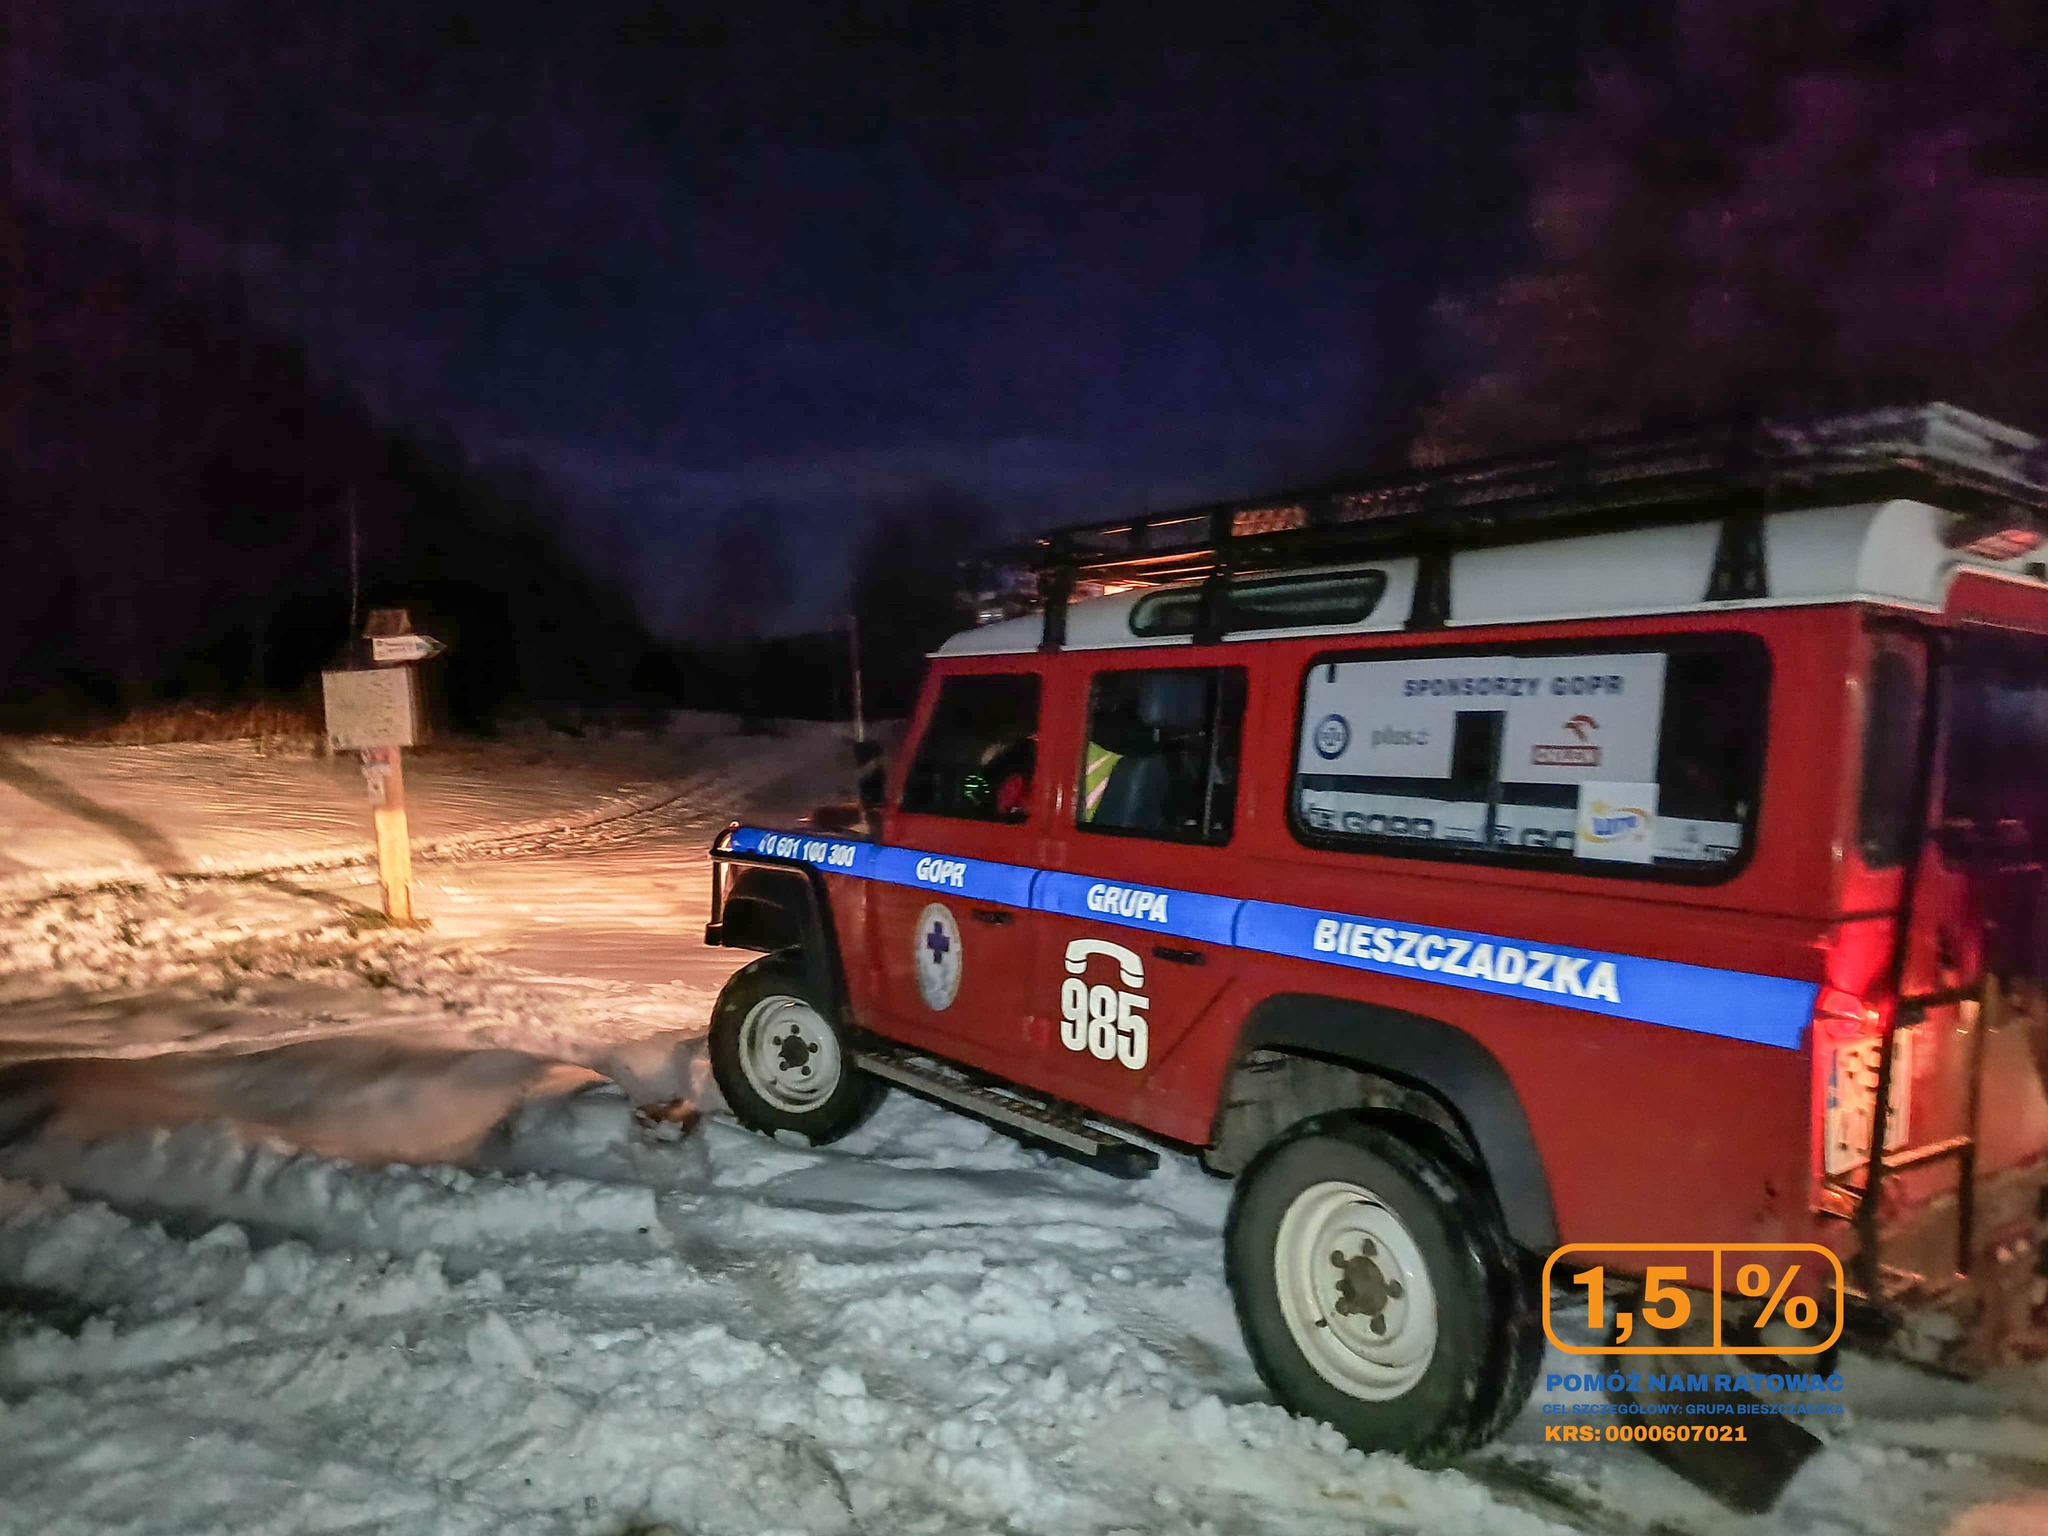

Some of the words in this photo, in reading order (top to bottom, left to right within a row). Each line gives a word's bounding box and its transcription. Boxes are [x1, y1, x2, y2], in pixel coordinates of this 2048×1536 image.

[1403, 676, 1541, 698] SPONSORZY
[1550, 675, 1625, 696] GOPR
[777, 837, 802, 858] 601
[803, 840, 829, 863] 100
[828, 844, 857, 867] 300
[916, 857, 967, 888] GOPR
[1086, 883, 1170, 924] GRUPA
[1313, 918, 1622, 1004] BIESZCZADZKA
[1060, 976, 1150, 1071] 985
